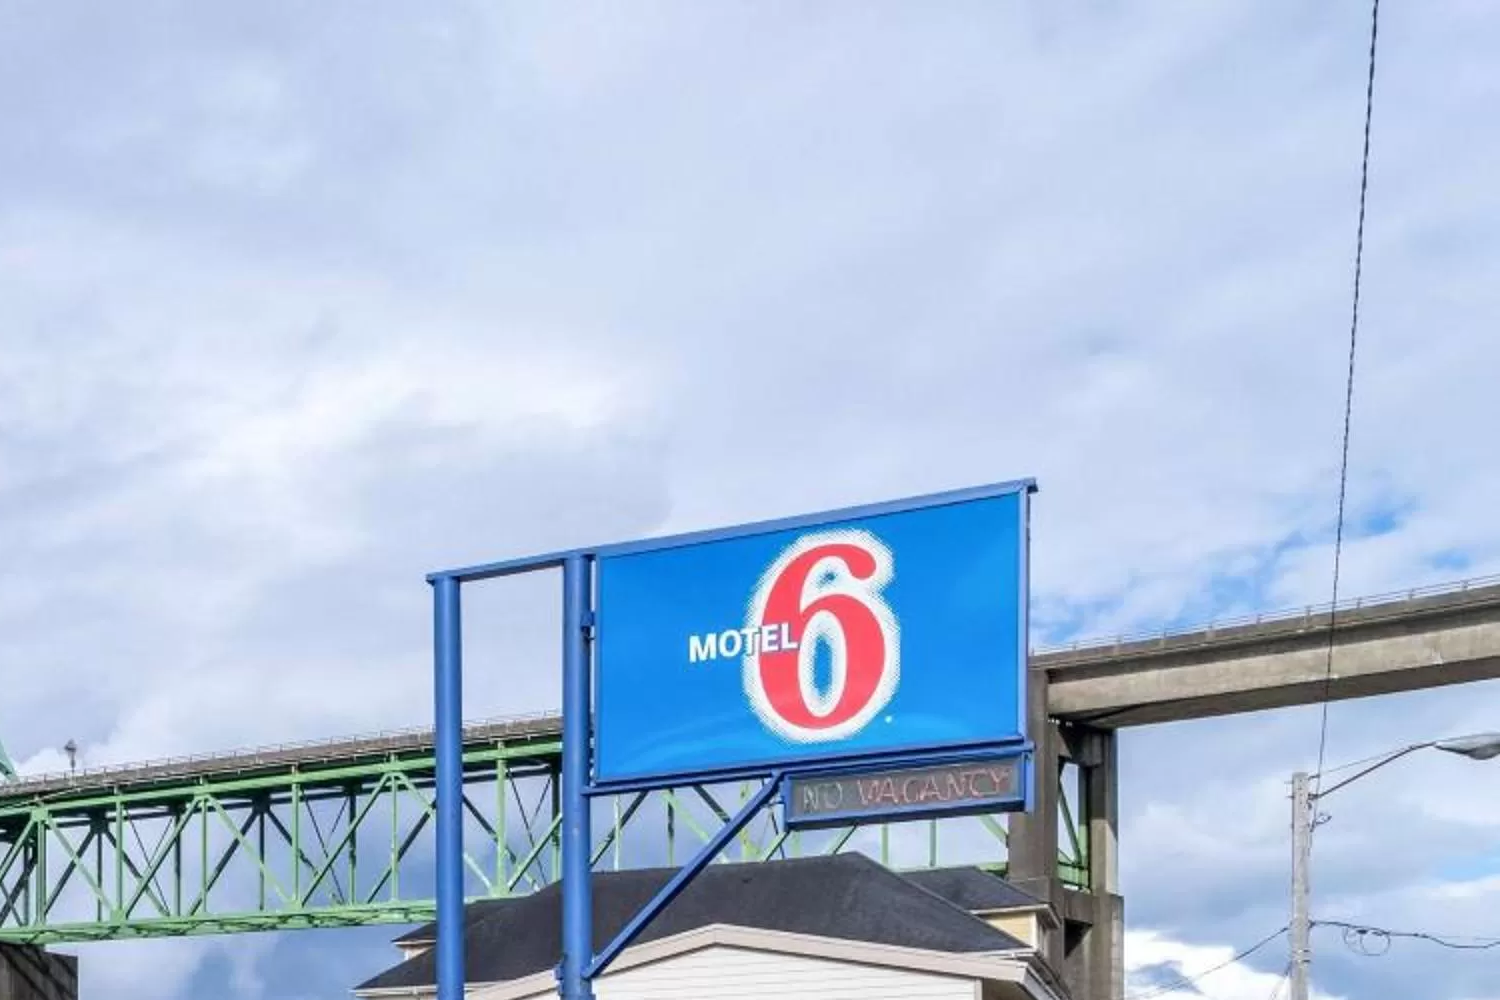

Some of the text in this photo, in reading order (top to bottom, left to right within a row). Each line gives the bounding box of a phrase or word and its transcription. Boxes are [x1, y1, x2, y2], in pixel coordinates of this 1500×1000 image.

[688, 541, 887, 731] MOTEL 6
[802, 766, 1010, 812] NO VACANCY
